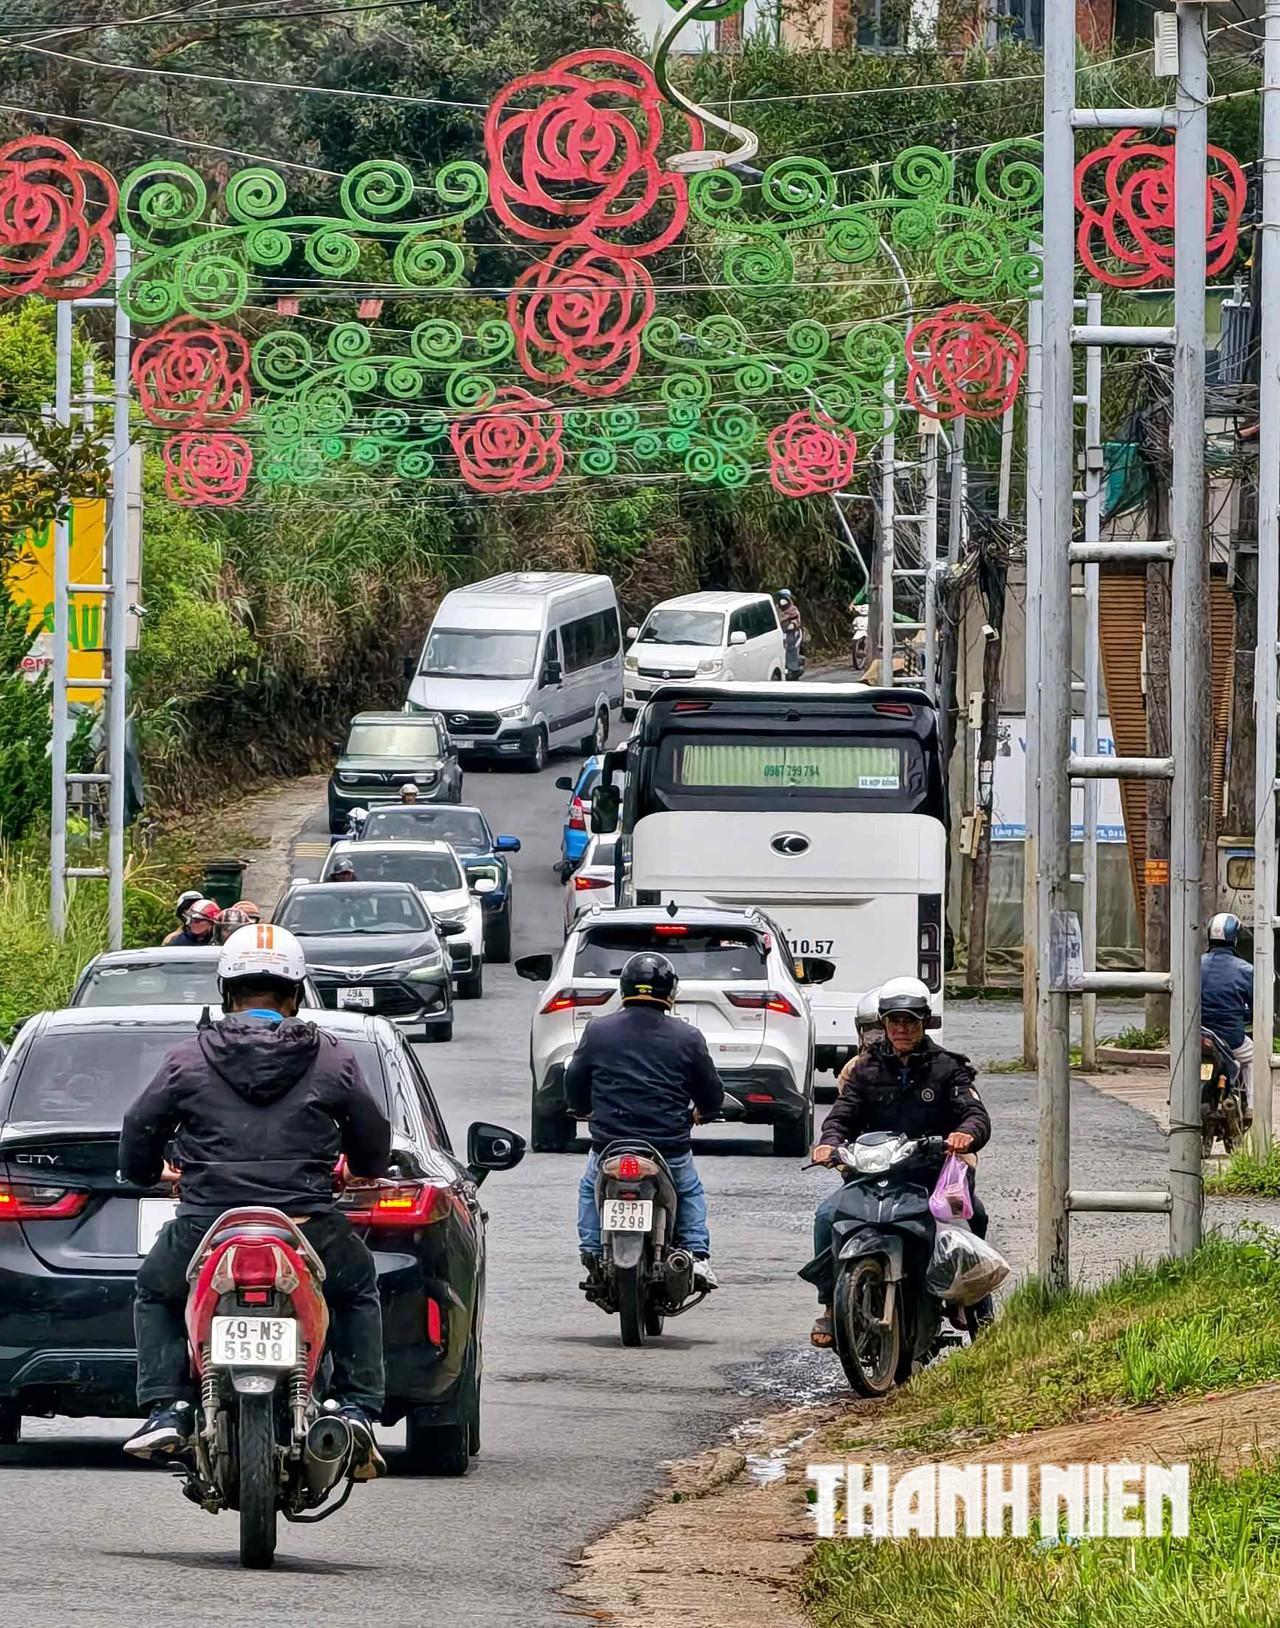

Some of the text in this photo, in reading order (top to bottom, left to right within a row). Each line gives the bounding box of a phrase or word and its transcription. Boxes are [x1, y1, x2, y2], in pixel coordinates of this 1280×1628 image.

[786, 940, 834, 954] 10.57
[16, 1153, 59, 1164] CITY
[611, 1201, 644, 1216] 49-P1
[610, 1215, 645, 1229] 5298
[225, 1320, 284, 1341] 49-N3
[224, 1340, 283, 1361] 5598
